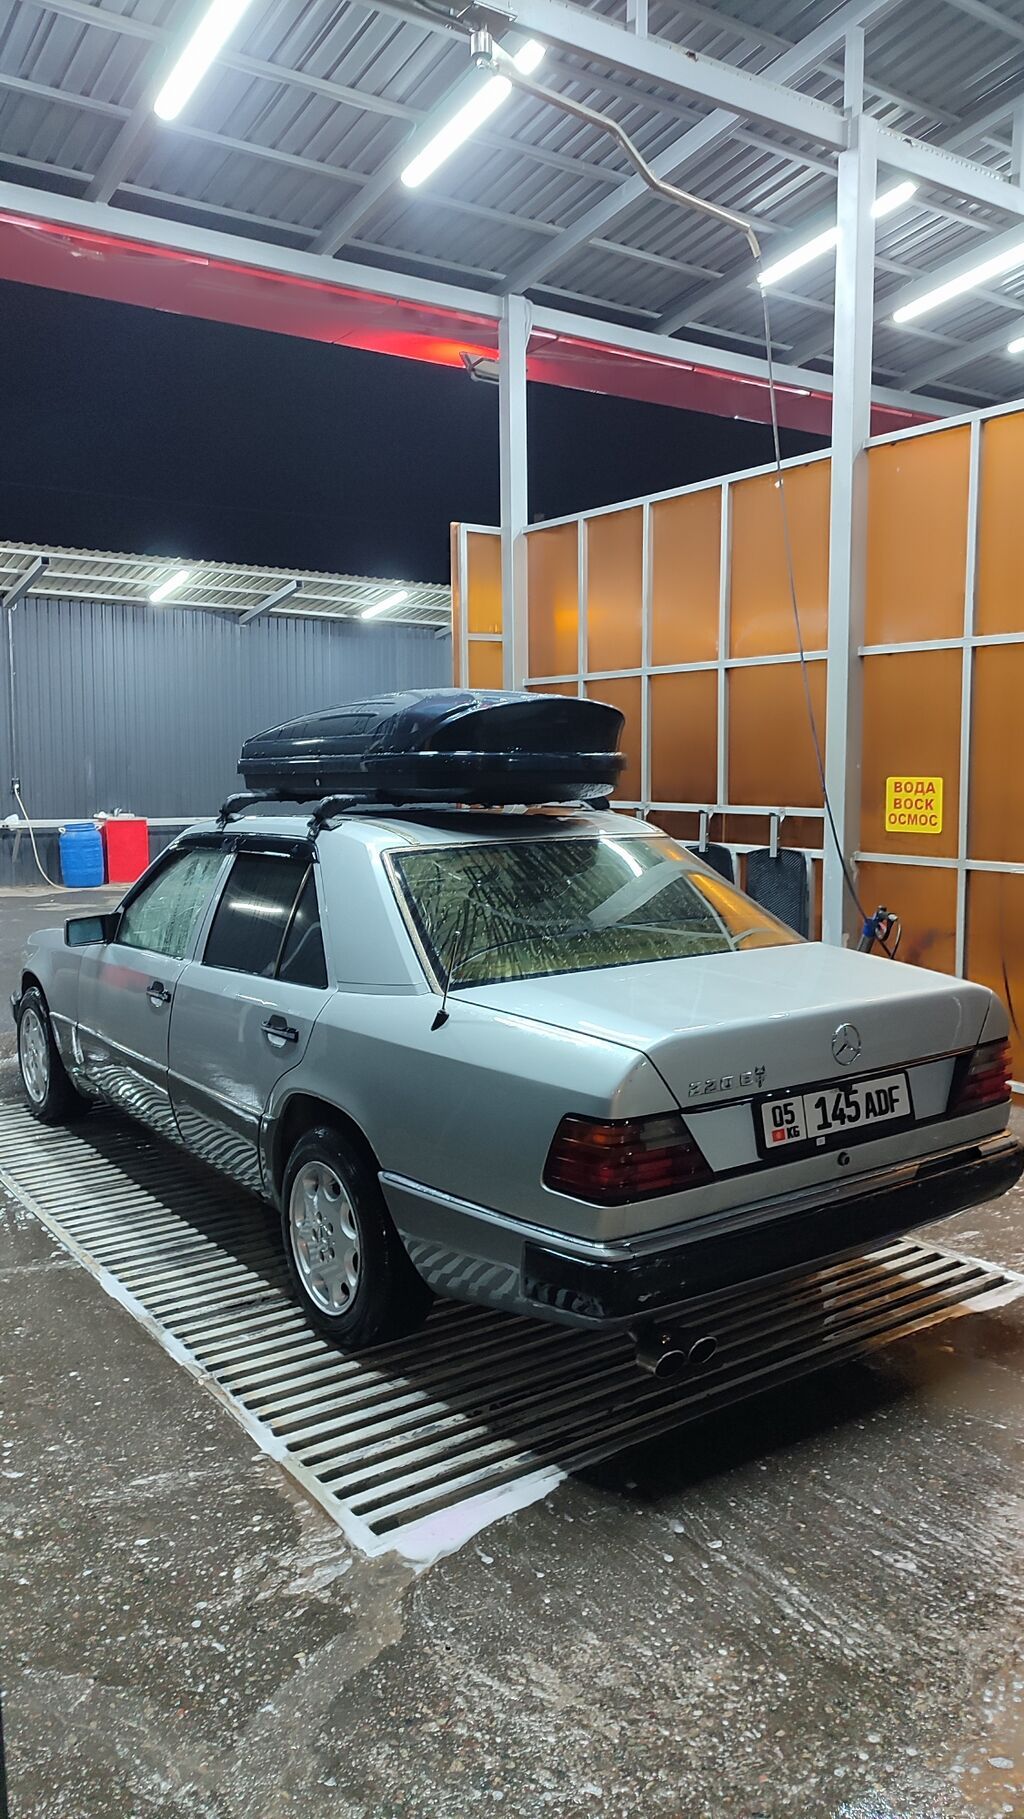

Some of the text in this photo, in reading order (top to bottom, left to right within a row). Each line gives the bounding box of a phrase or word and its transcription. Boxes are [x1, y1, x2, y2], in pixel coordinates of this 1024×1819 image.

[894, 782, 935, 795] ВОДА
[893, 798, 934, 810] ВОСК
[889, 813, 938, 826] ОСМОС
[771, 1085, 900, 1131] 05 145 ADF
